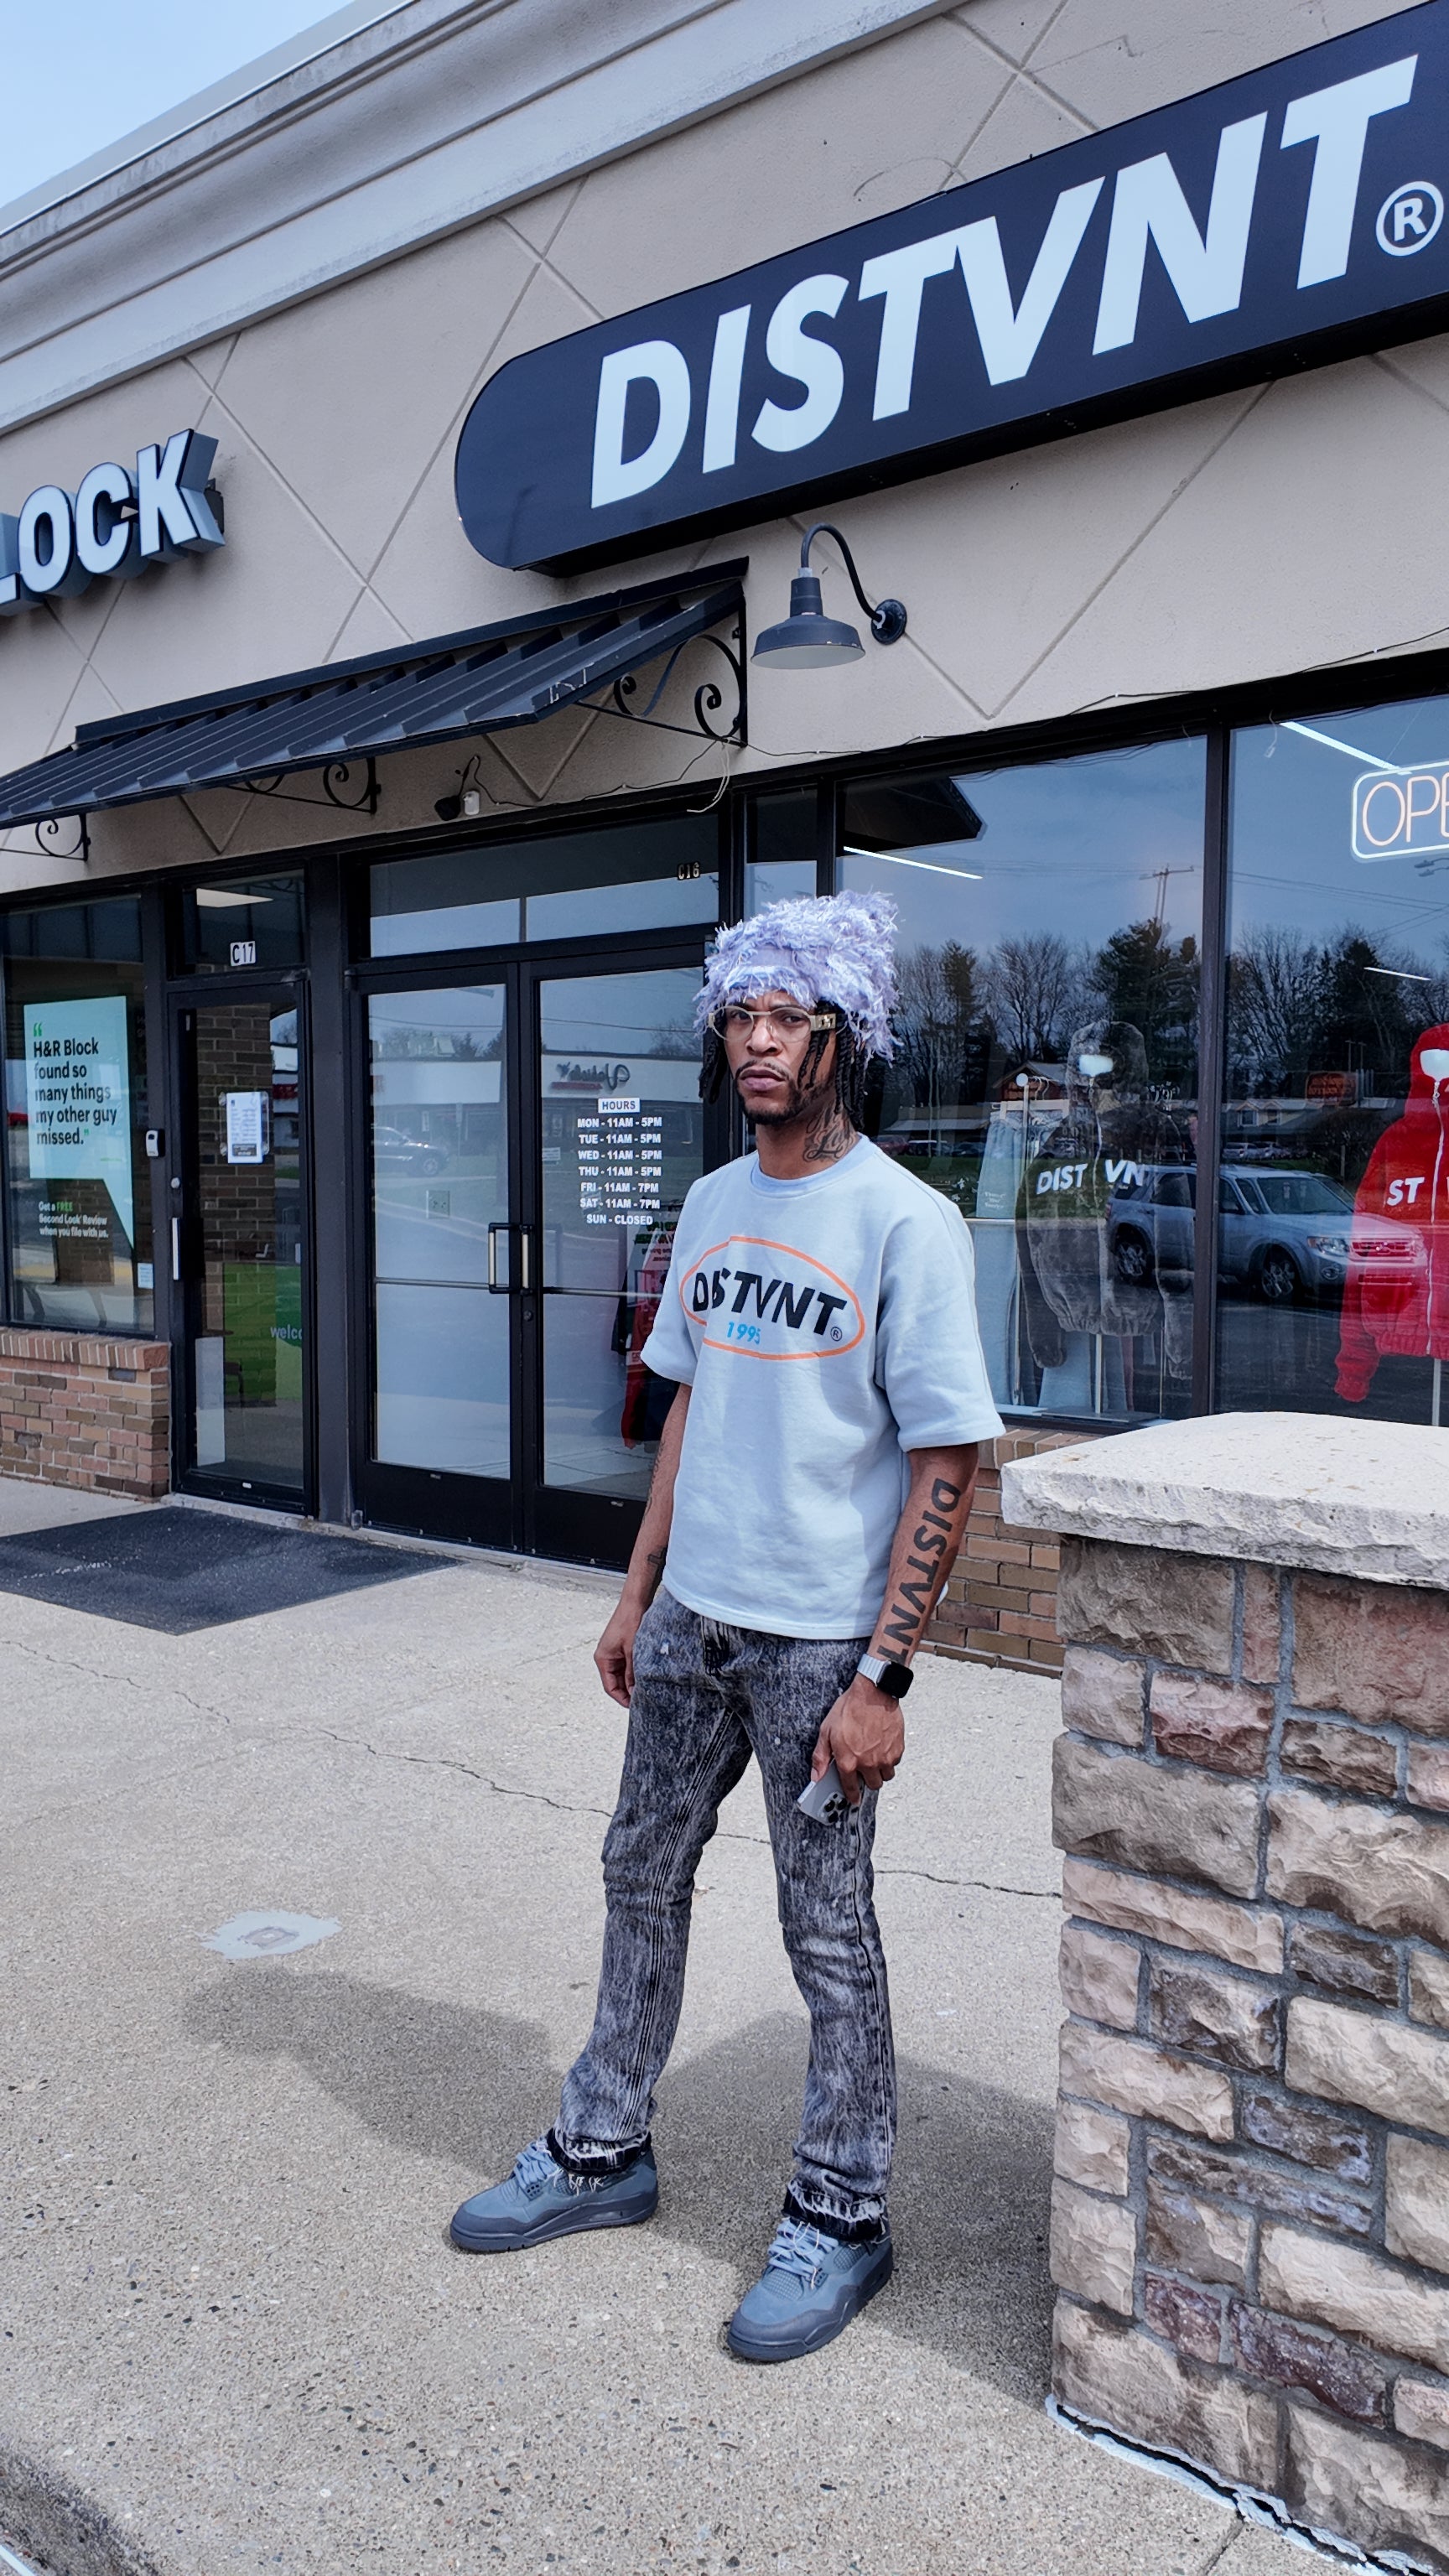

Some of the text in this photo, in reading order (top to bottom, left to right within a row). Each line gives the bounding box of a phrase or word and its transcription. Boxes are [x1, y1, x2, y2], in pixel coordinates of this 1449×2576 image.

[590, 53, 1419, 509] DISTVNT
[0, 428, 201, 605] OCK
[678, 862, 699, 879] C16
[232, 943, 253, 963] C17
[34, 1037, 99, 1057] H&R Block
[34, 1061, 87, 1079] found so
[35, 1083, 111, 1104] many things
[602, 1100, 636, 1110] HOURS
[36, 1105, 117, 1126] my other guy
[577, 1118, 600, 1128] MON
[607, 1118, 634, 1128] 11AM
[641, 1117, 662, 1127] 5PM
[579, 1134, 599, 1144] TUE
[606, 1134, 632, 1144] 11AM
[640, 1134, 662, 1144] 5PM
[578, 1150, 600, 1161] WED
[607, 1150, 634, 1160] 11AM
[641, 1150, 662, 1160] 5PM
[578, 1166, 599, 1176] THU
[606, 1166, 633, 1176] 11AM
[641, 1166, 662, 1176] 5PM
[1036, 1163, 1088, 1195] DIST
[580, 1182, 596, 1192] FRI
[604, 1182, 631, 1192] 11AM
[638, 1182, 659, 1192] 7PM
[1387, 1176, 1425, 1206] ST
[39, 1201, 73, 1212] Get a FREE
[579, 1197, 598, 1208] SAT
[605, 1198, 631, 1208] 11AM
[639, 1199, 661, 1209] 7PM
[39, 1213, 63, 1223] Second
[82, 1215, 107, 1225] Review
[587, 1214, 607, 1223] SUN
[615, 1215, 653, 1225] CLOSED
[39, 1225, 57, 1236] when
[58, 1228, 70, 1238] you
